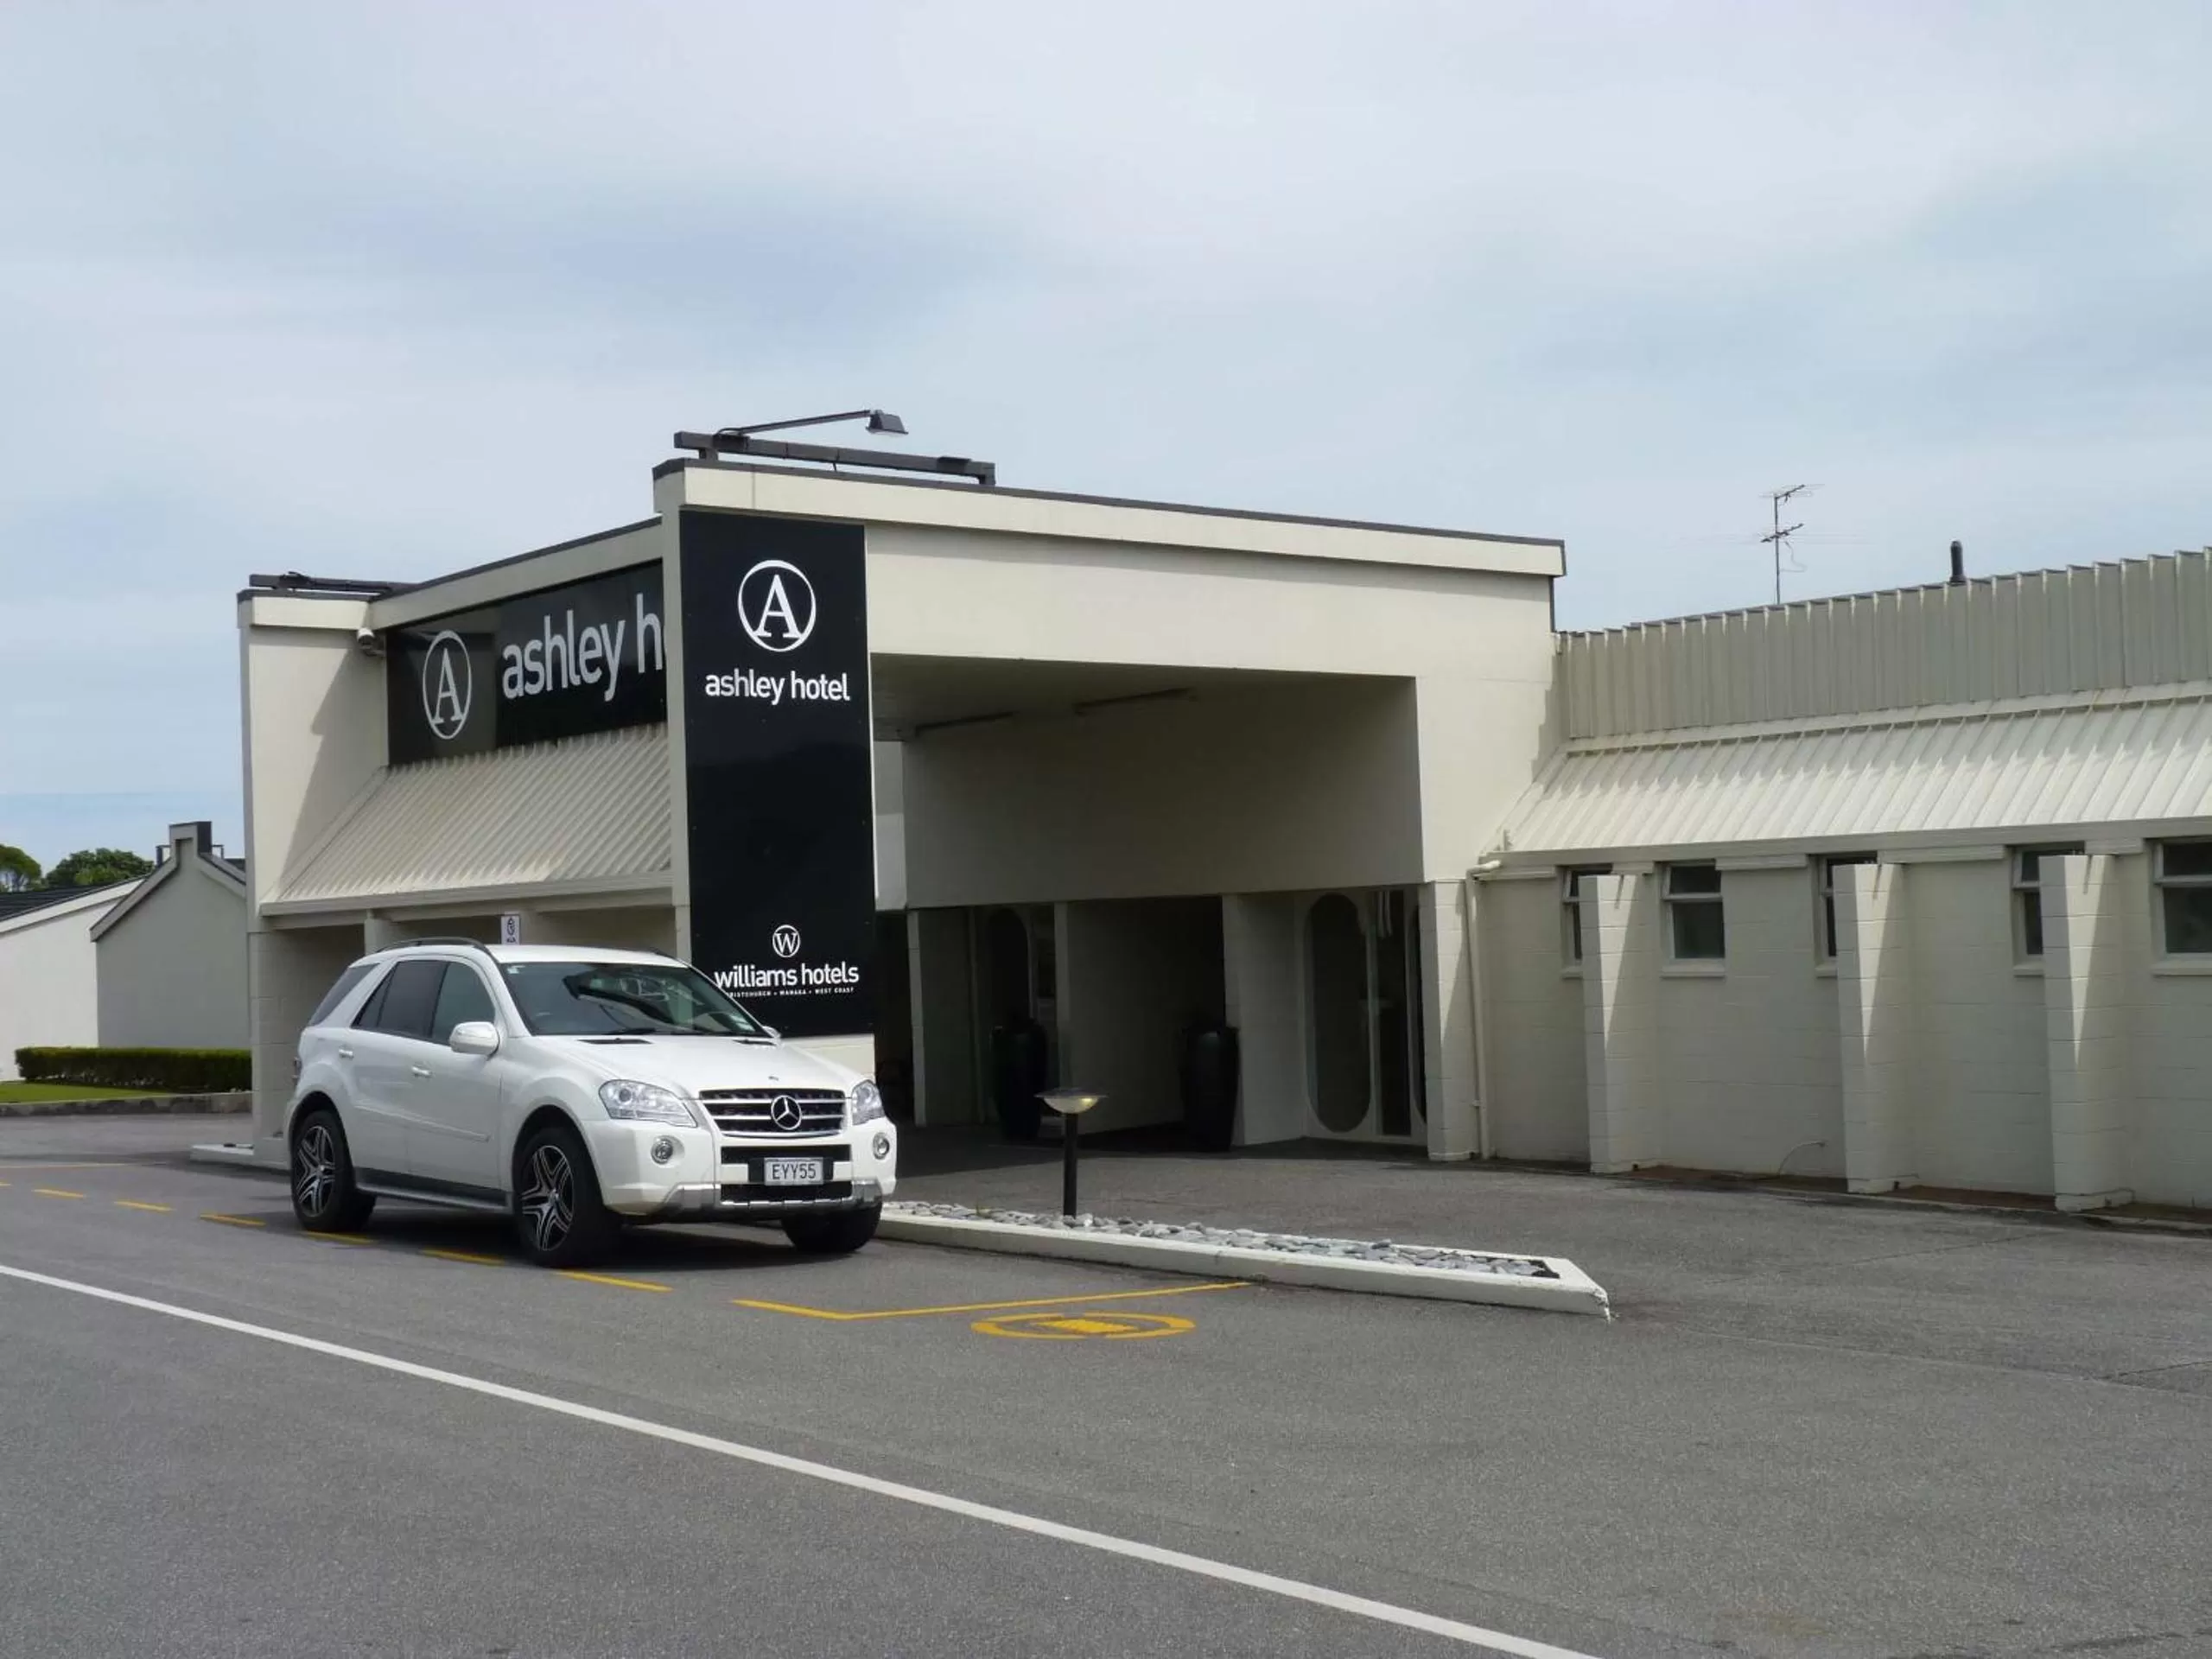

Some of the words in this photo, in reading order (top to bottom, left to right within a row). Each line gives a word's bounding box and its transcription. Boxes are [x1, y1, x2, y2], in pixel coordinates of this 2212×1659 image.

[502, 609, 626, 702] ashley
[636, 593, 667, 673] h
[705, 669, 785, 705] ashley
[791, 671, 850, 702] hotel
[714, 964, 797, 988] williams
[801, 961, 859, 985] hotels
[772, 1164, 817, 1179] EYY55
